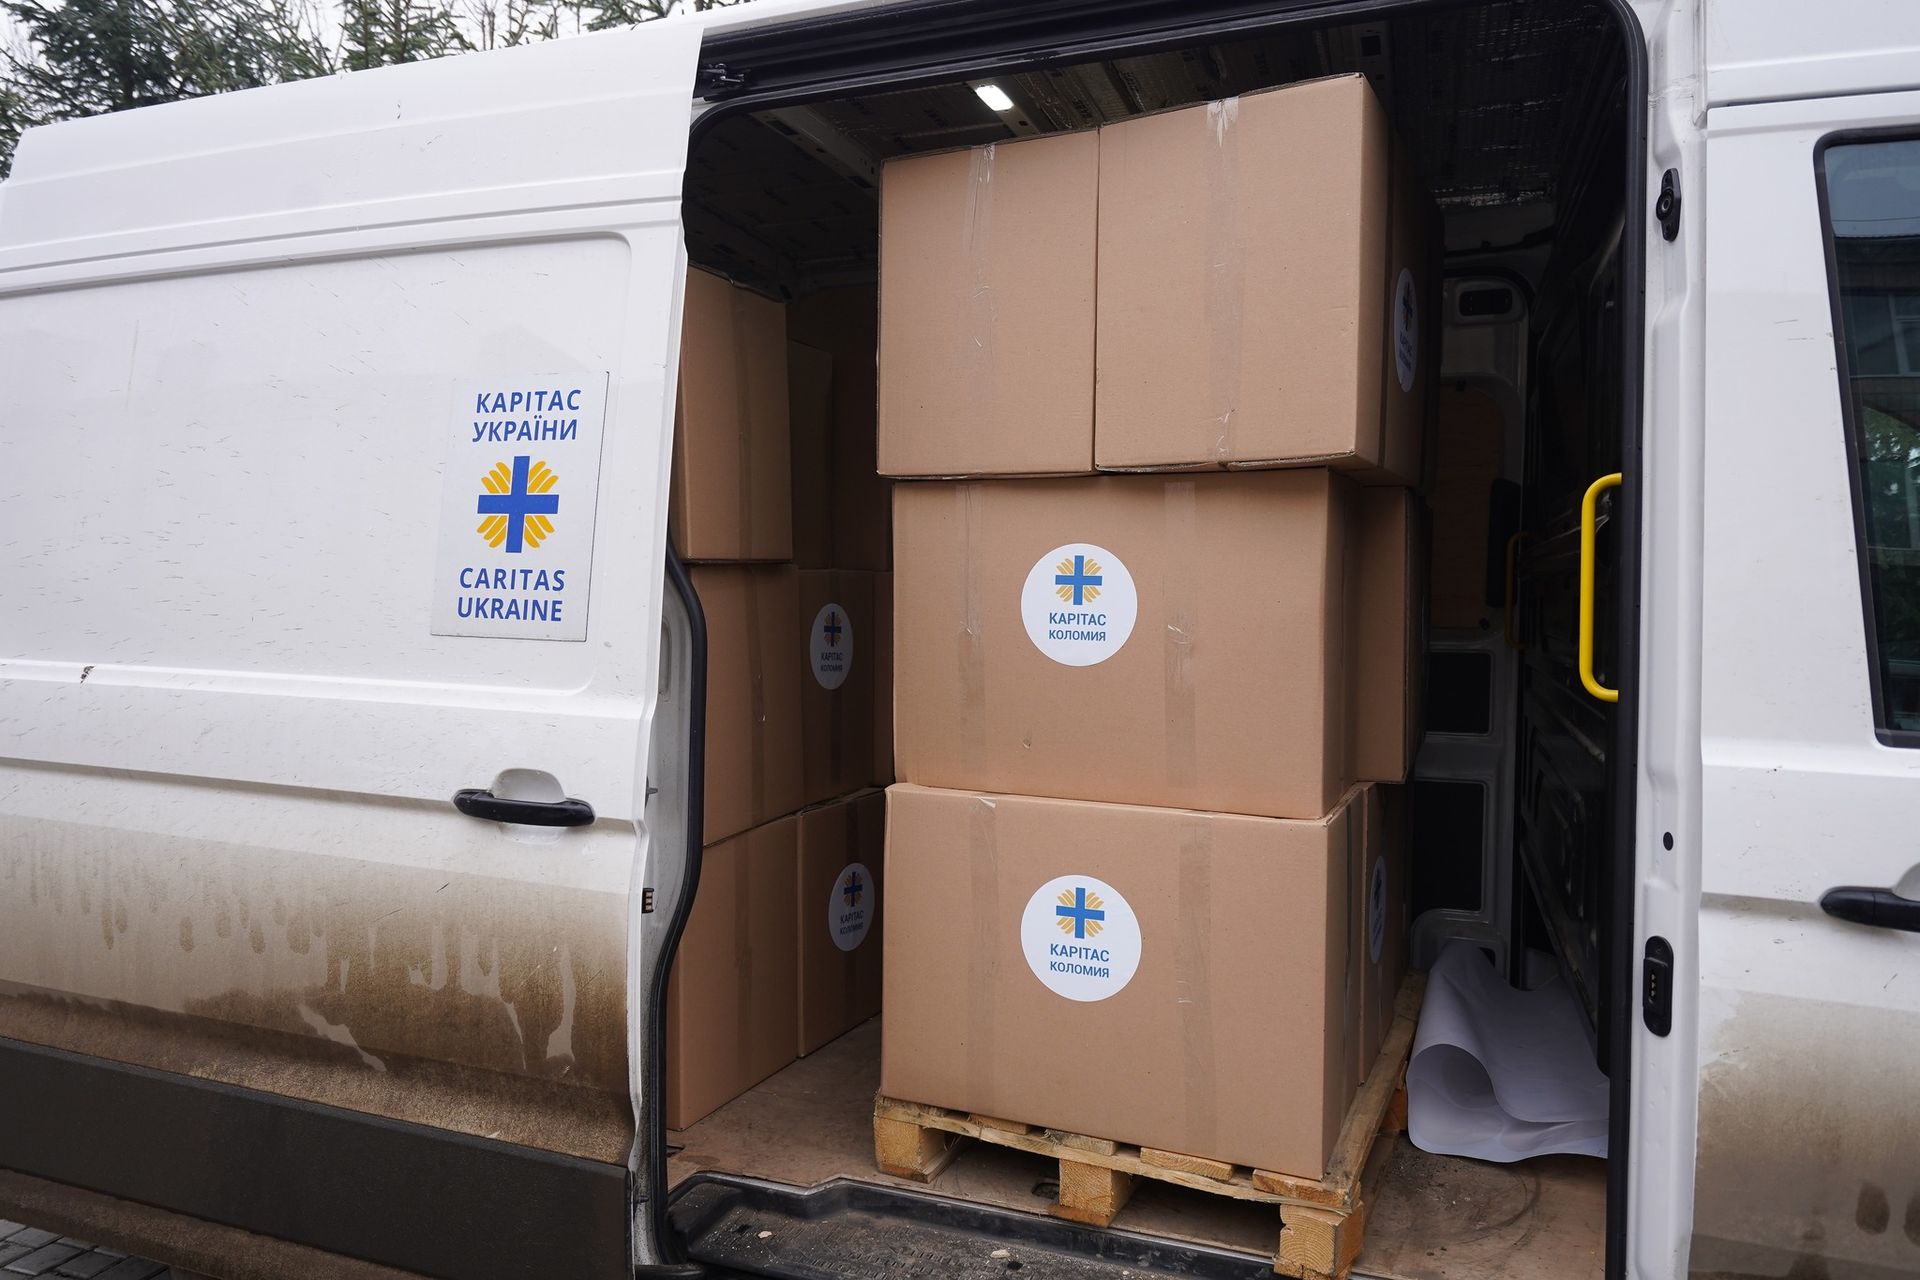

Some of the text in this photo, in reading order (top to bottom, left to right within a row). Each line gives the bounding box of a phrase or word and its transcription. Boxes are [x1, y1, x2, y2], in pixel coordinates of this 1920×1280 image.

[476, 389, 581, 414] КАРІТАС
[472, 414, 578, 443] УКРАЇНИ
[459, 567, 565, 592] CARITAS
[457, 597, 563, 622] UKRAINE
[1049, 612, 1107, 627] КАРІТАС
[1048, 629, 1106, 642] КОЛОМИЯ
[1050, 943, 1110, 963] КАРІТАС
[1050, 960, 1110, 978] КОЛОМИЯ
